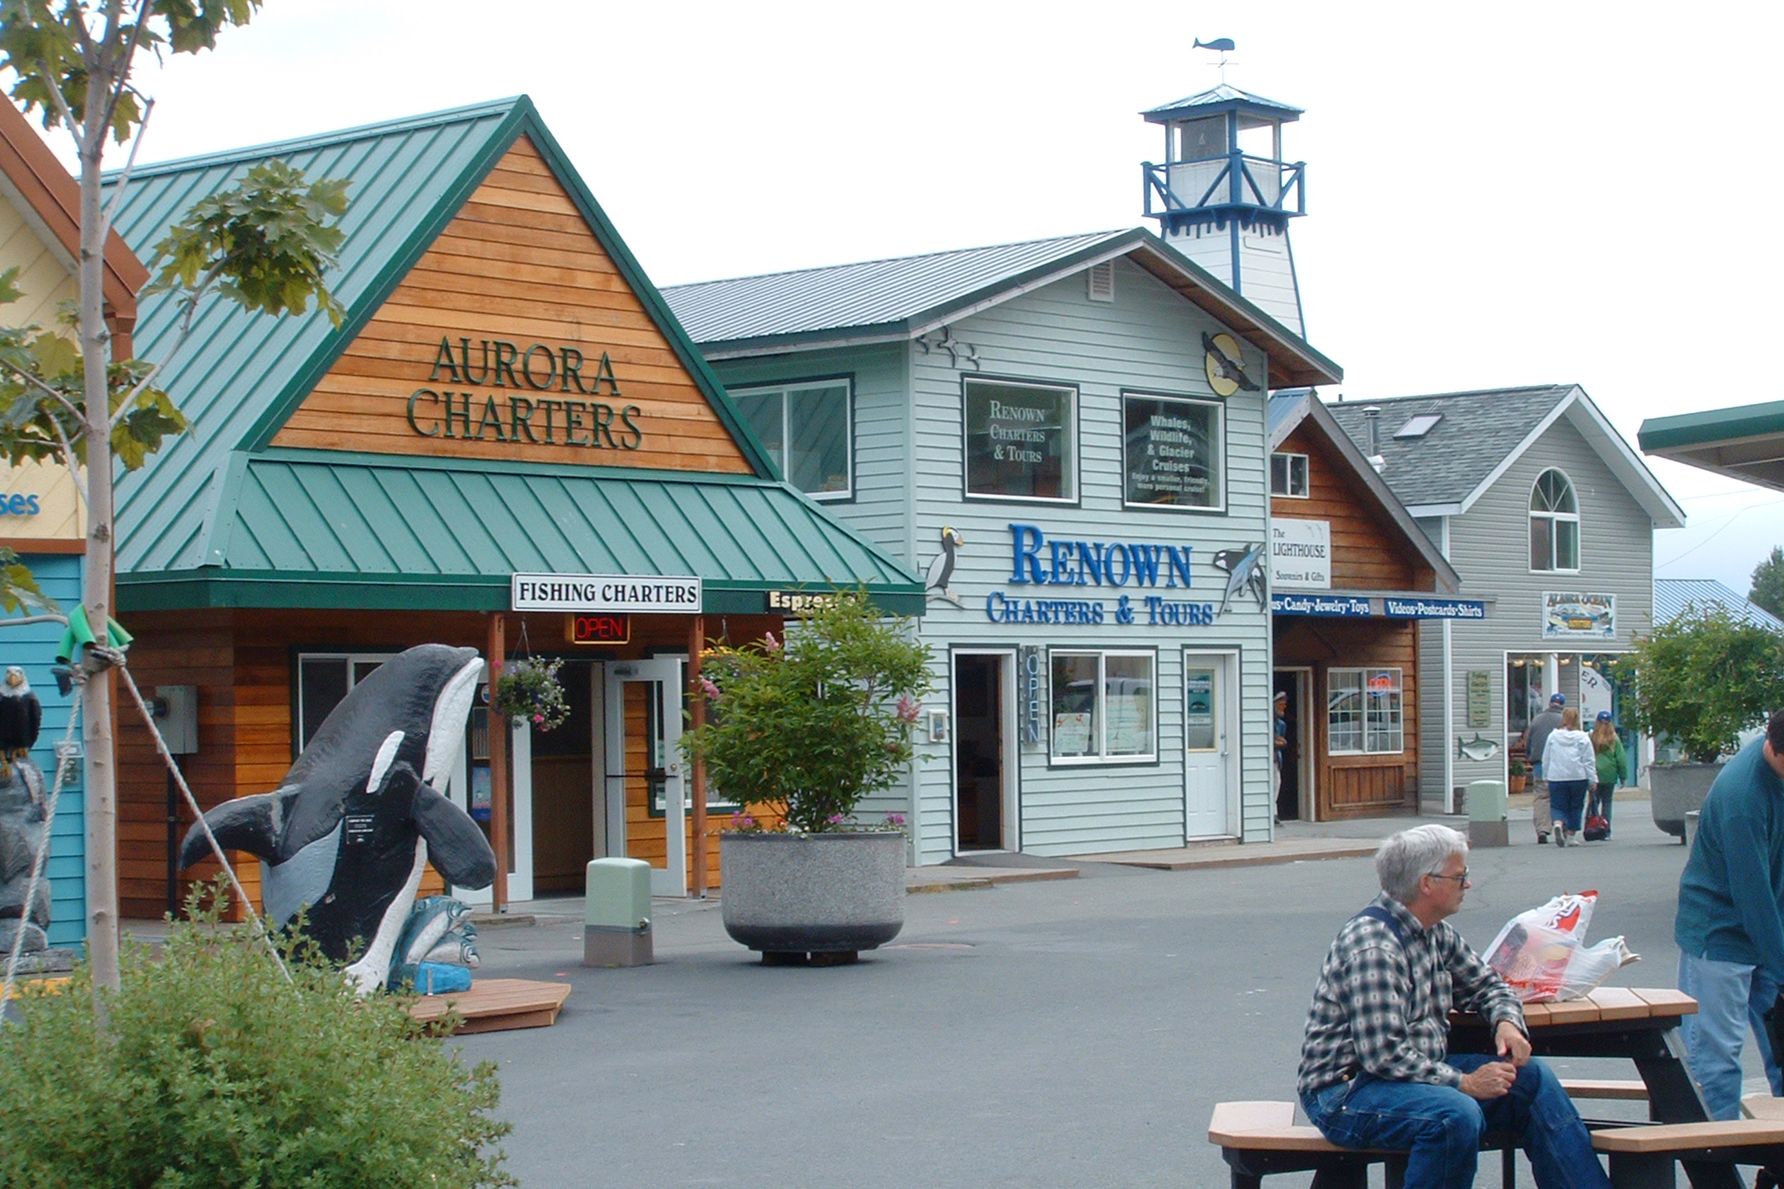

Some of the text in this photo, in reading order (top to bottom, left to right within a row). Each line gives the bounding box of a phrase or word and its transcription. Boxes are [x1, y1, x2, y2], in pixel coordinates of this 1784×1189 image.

[428, 336, 621, 396] AURORA
[406, 387, 642, 450] CHARTERS
[989, 400, 1046, 422] RENOWN
[990, 424, 1046, 443] CHARTERS
[1150, 415, 1191, 431] Whales,
[993, 444, 1042, 463] & TOURS
[1147, 443, 1195, 459] & Glacier
[1152, 459, 1190, 472] Cruises
[1273, 528, 1285, 538] The
[1008, 523, 1193, 588] RENOWN
[1273, 542, 1326, 558] LIGHTHOUSE
[519, 582, 697, 604] FISHING CHARTERS
[769, 591, 856, 611] Espreso
[986, 591, 1214, 625] CHARTERS & TOURS
[575, 617, 624, 639] OPEN
[1027, 654, 1040, 742] OPEN
